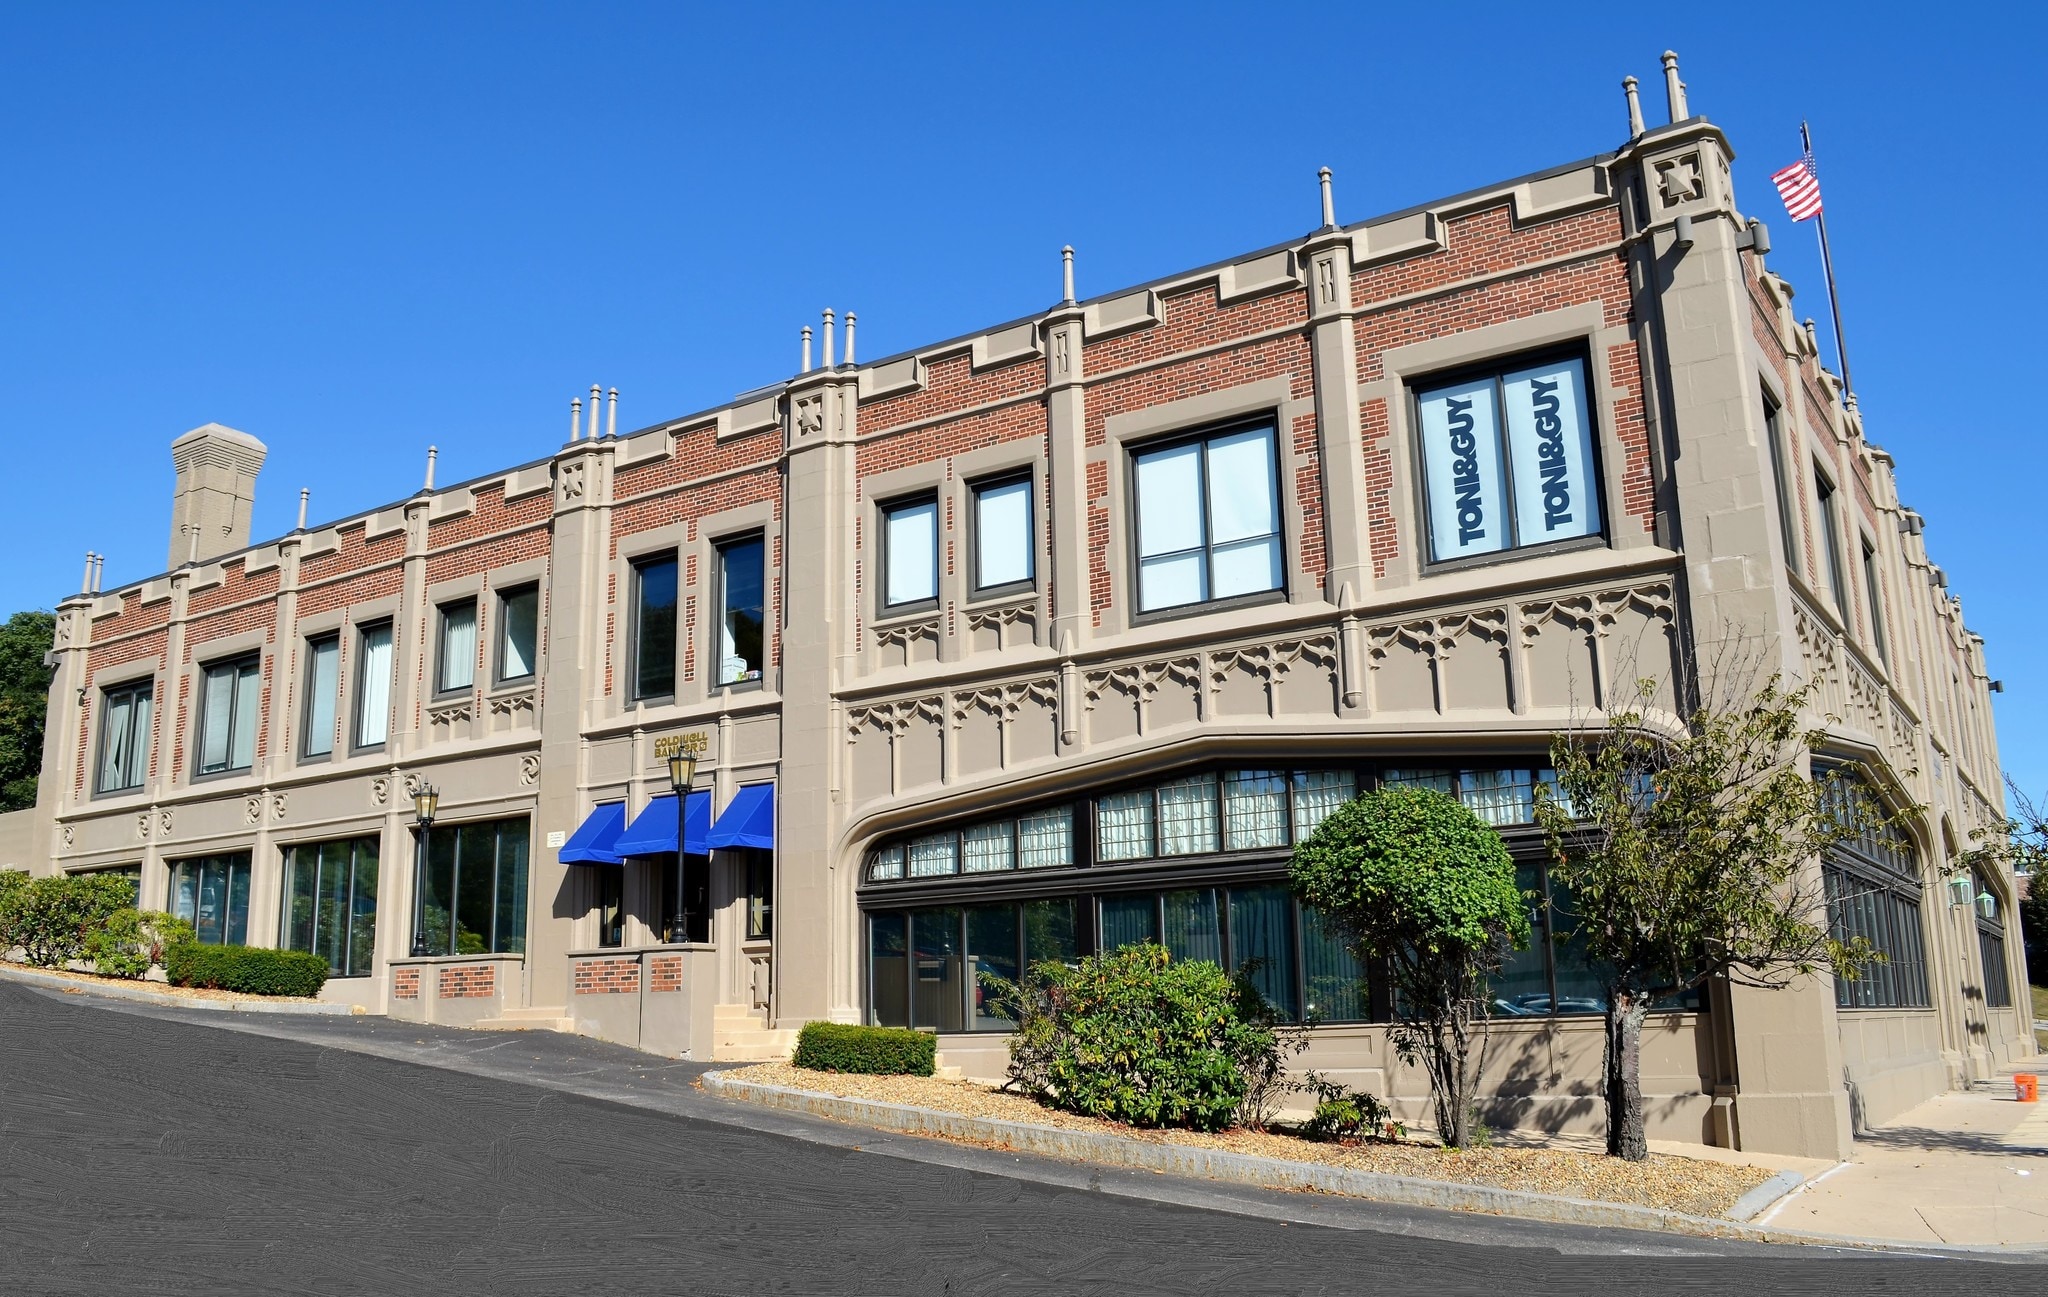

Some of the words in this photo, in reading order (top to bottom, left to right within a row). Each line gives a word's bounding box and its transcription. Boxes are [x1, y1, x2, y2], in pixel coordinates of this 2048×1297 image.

[1446, 397, 1486, 547] TONI&GUY
[1530, 378, 1573, 531] TONI&GUY
[654, 731, 708, 748] COLDWELL
